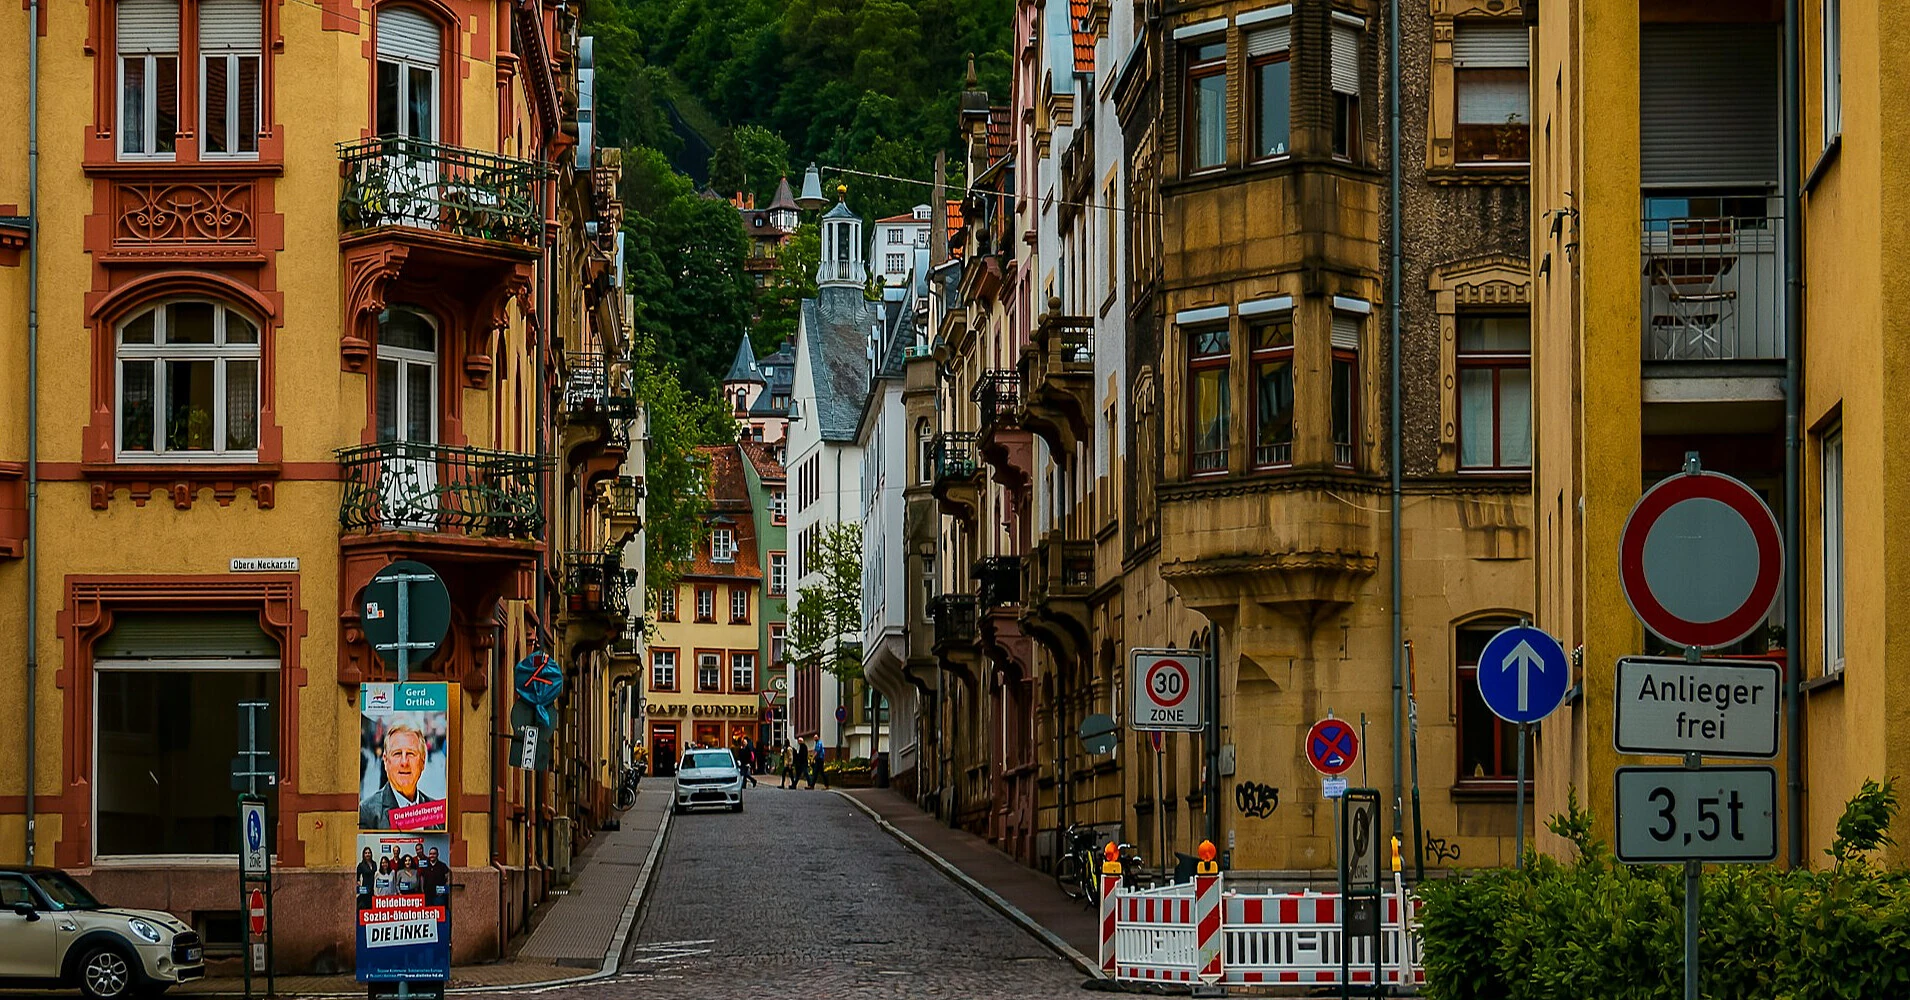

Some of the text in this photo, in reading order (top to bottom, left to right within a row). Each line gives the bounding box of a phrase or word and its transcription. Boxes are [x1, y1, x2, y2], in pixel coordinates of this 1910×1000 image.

[233, 560, 296, 569] Obere Neckarstr.
[1155, 672, 1180, 694] 30
[405, 688, 426, 696] Gerd
[1638, 674, 1764, 710] Anlieger
[405, 698, 436, 706] Ortlieb
[646, 704, 757, 717] CAFE GUNDEL
[1150, 708, 1184, 721] ZONE
[1676, 711, 1725, 739] frei
[394, 805, 443, 820] Die Heidelberger
[375, 897, 423, 908] Heidelberg:
[371, 926, 391, 943] DIE
